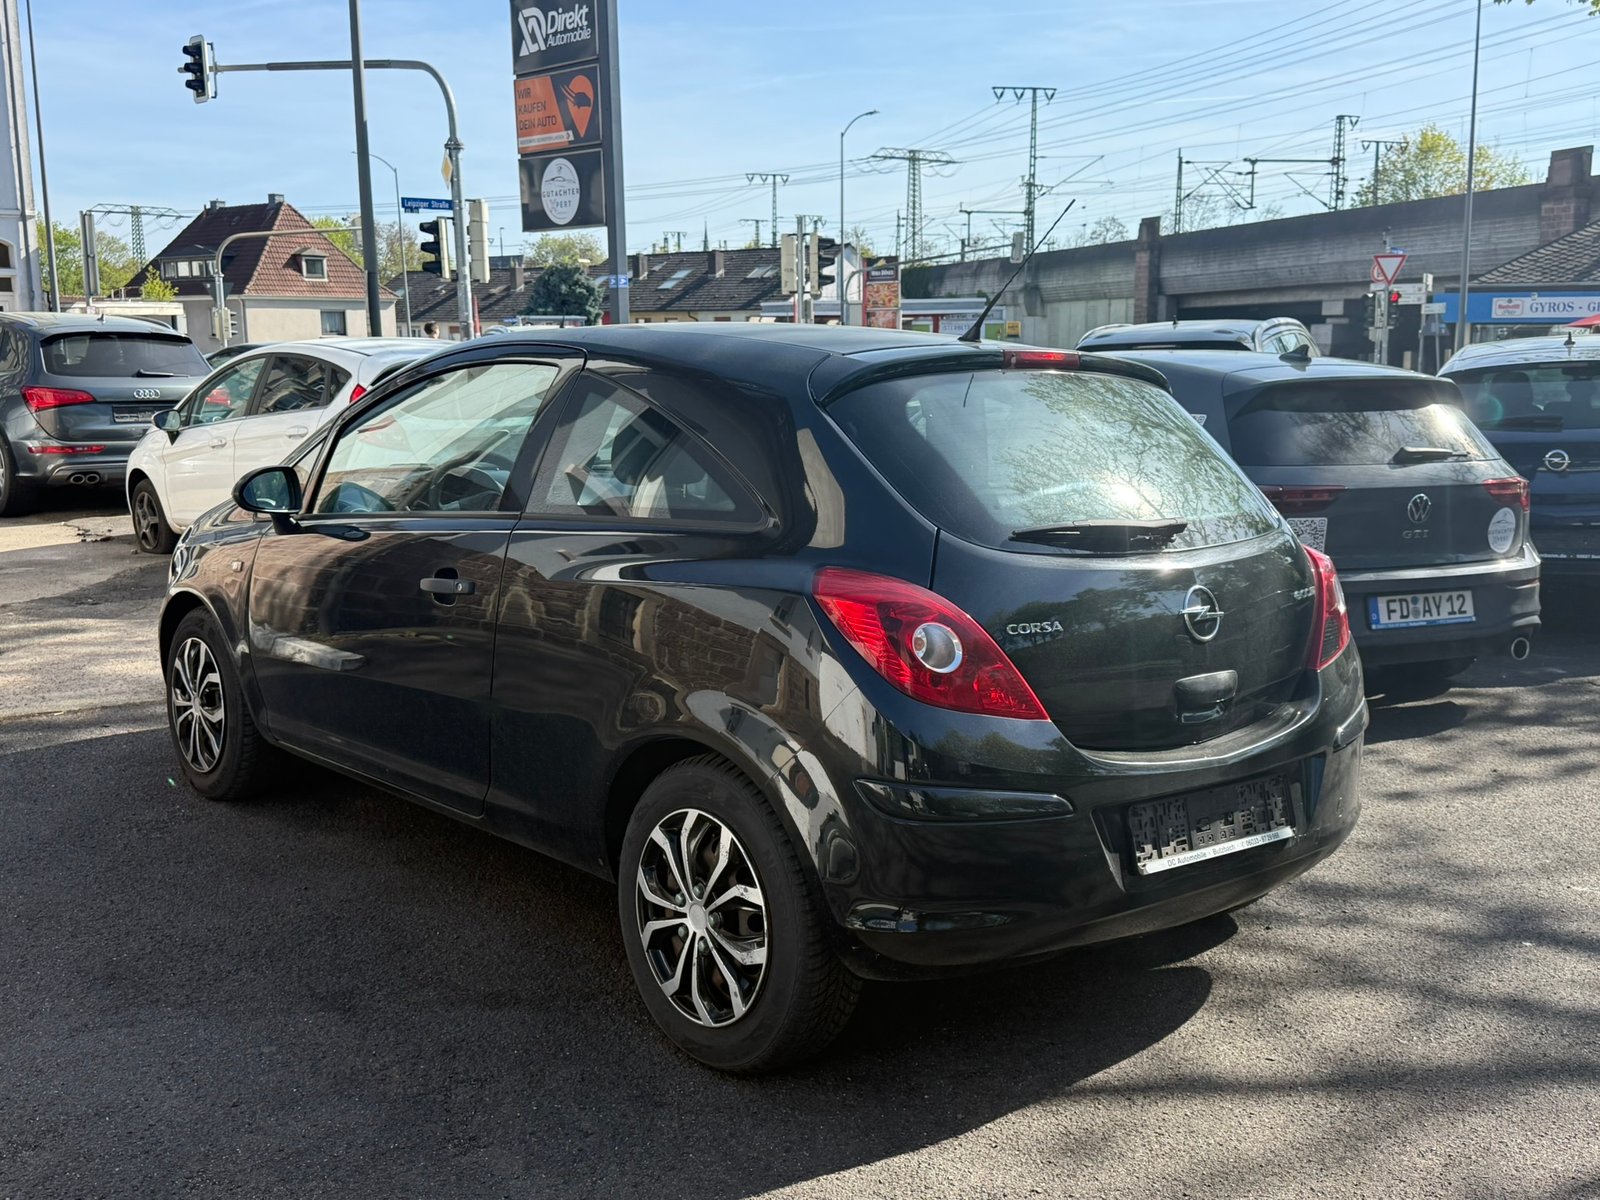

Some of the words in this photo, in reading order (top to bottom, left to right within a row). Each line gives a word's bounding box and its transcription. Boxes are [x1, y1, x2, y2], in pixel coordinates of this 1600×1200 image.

[547, 4, 588, 35] Direkt
[547, 27, 592, 48] Automobile
[518, 88, 531, 98] WIR
[518, 101, 546, 115] KAUFEN
[519, 118, 536, 131] DEIN
[537, 115, 557, 127] AUTO
[542, 188, 579, 198] GUTACHTER
[1529, 301, 1575, 313] GYROS
[1587, 302, 1600, 313] G
[1402, 529, 1429, 539] GTI
[1386, 598, 1410, 620] FD
[1422, 596, 1442, 618] AY
[1446, 593, 1467, 615] 12
[1006, 620, 1064, 635] CORSA
